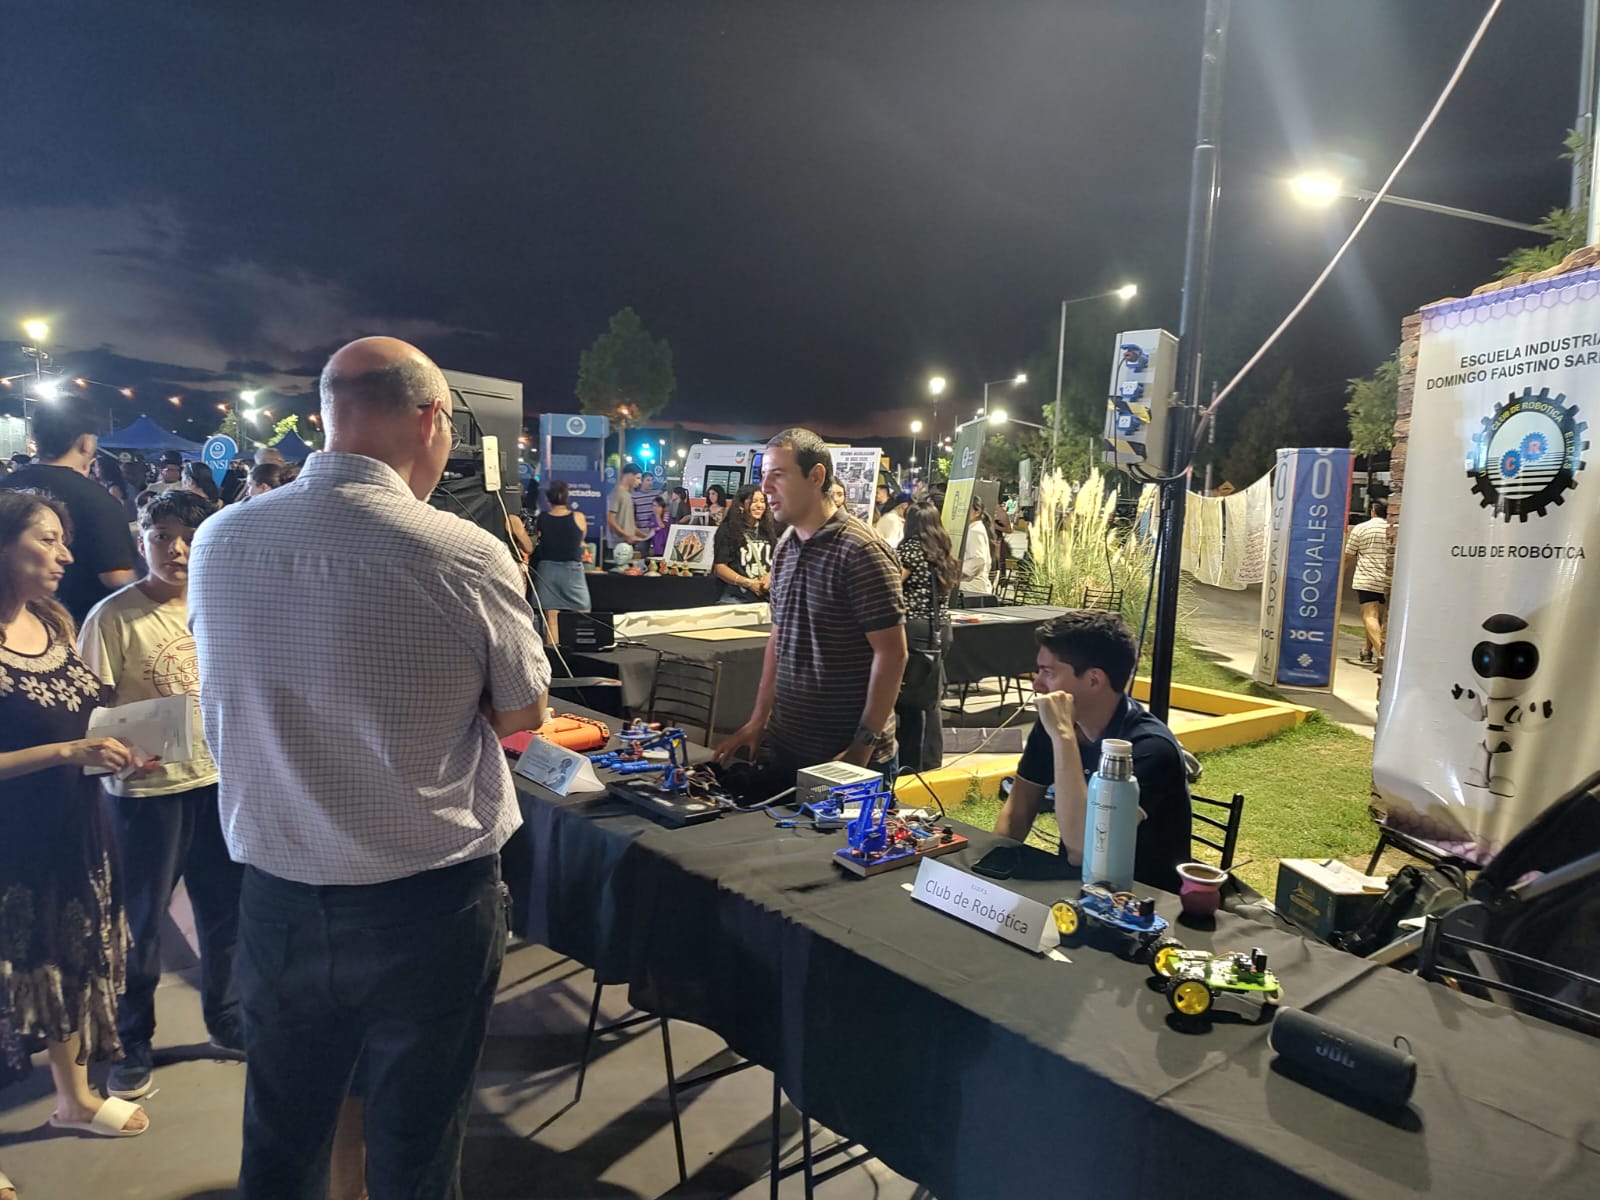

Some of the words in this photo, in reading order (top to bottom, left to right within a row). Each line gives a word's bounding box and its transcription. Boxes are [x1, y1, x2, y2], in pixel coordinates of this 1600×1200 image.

[1460, 348, 1521, 368] ESCUELA
[1426, 370, 1487, 390] DOMINGO
[1491, 357, 1560, 380] FAUSTINO
[1564, 351, 1600, 368] SAR
[1491, 410, 1511, 431] CLUB
[1505, 457, 1516, 471] C
[1299, 504, 1328, 618] SOCIALES
[1451, 545, 1487, 558] CLUB
[1490, 545, 1505, 558] DE
[1508, 543, 1586, 559] ROBÓTCA
[925, 879, 951, 900] Club
[953, 891, 970, 909] de
[971, 898, 1029, 935] Robótica
